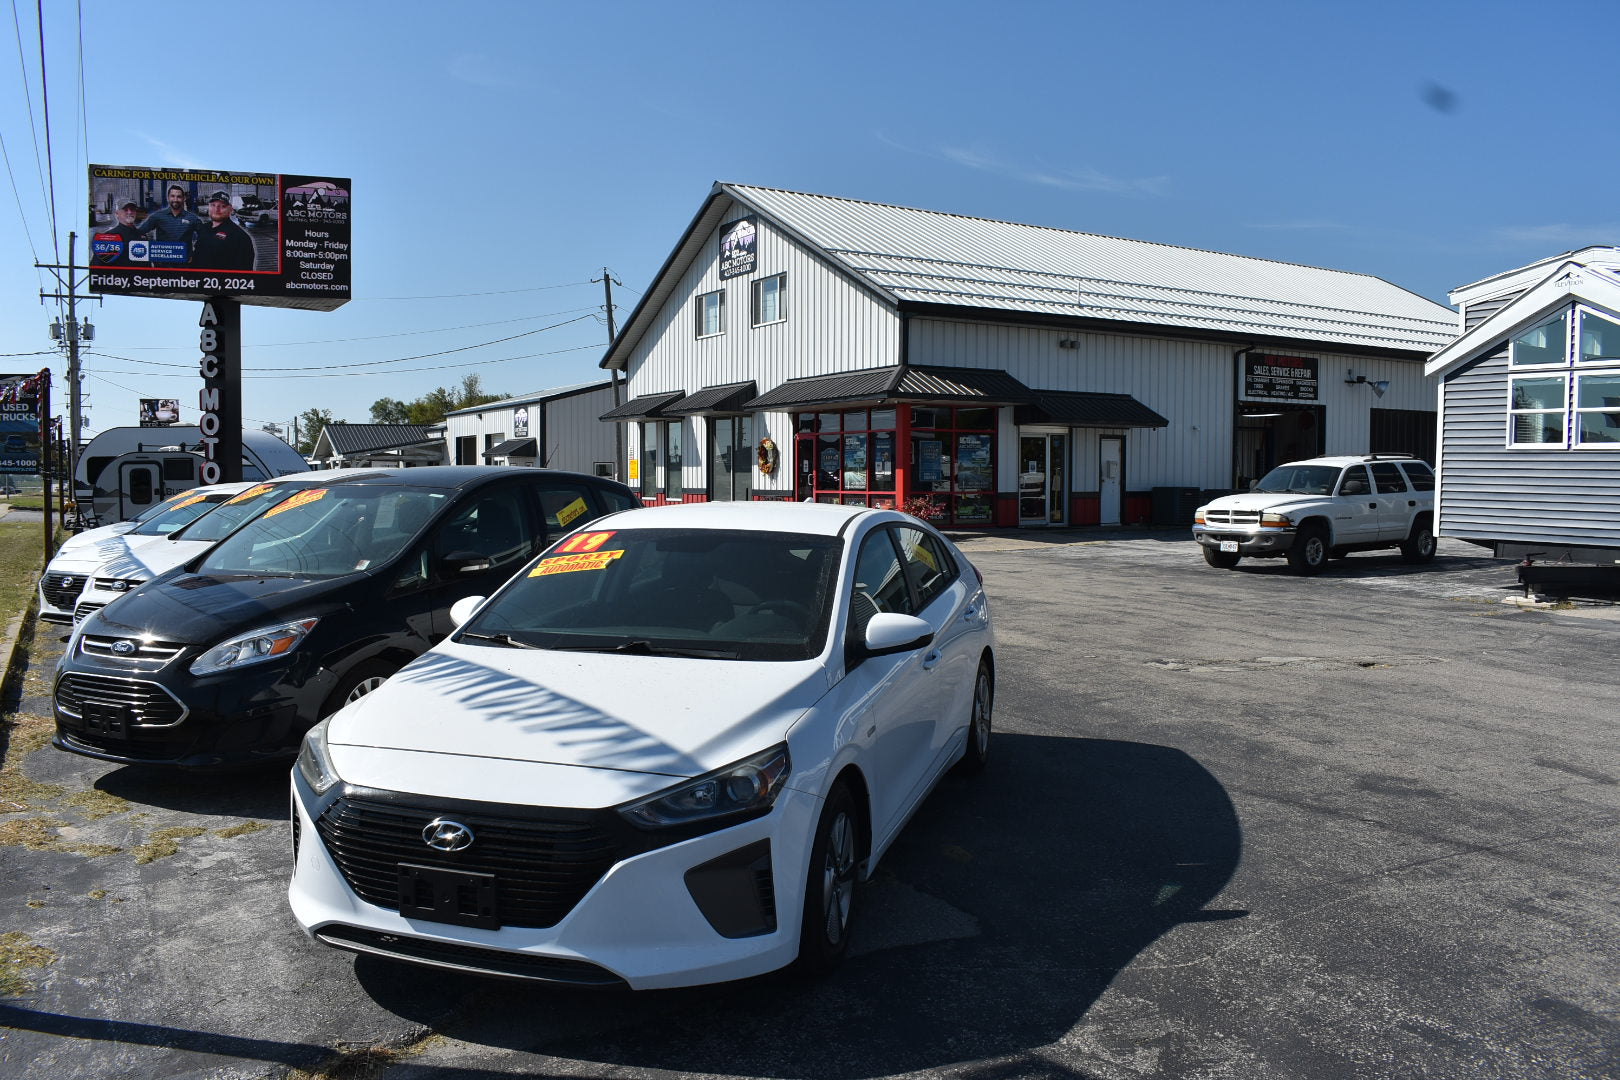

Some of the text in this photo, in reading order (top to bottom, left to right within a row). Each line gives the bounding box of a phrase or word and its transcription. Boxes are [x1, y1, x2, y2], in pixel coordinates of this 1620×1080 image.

[94, 169, 274, 185] CARING FOR YOUR VEHICLE AS OUR OWN
[286, 209, 347, 219] ABC MOTORS
[305, 230, 329, 238] Hours
[94, 243, 121, 251] 36/36
[285, 240, 318, 249] Monday
[324, 241, 348, 250] Friday
[286, 250, 348, 260] 8:00am-5:00pm
[732, 253, 755, 267] MOTORS
[299, 261, 335, 271] Saturday
[300, 272, 334, 280] CLOSED
[90, 275, 255, 290] Friday, September 20, 2024
[286, 281, 349, 291] abcmotors.com
[1271, 367, 1290, 376] SERVICE
[1295, 369, 1312, 378] REPAIR
[3, 403, 29, 412] USED
[562, 533, 609, 552] 19
[541, 551, 622, 566] SPORTY
[540, 560, 604, 575] AUTOMATIC
